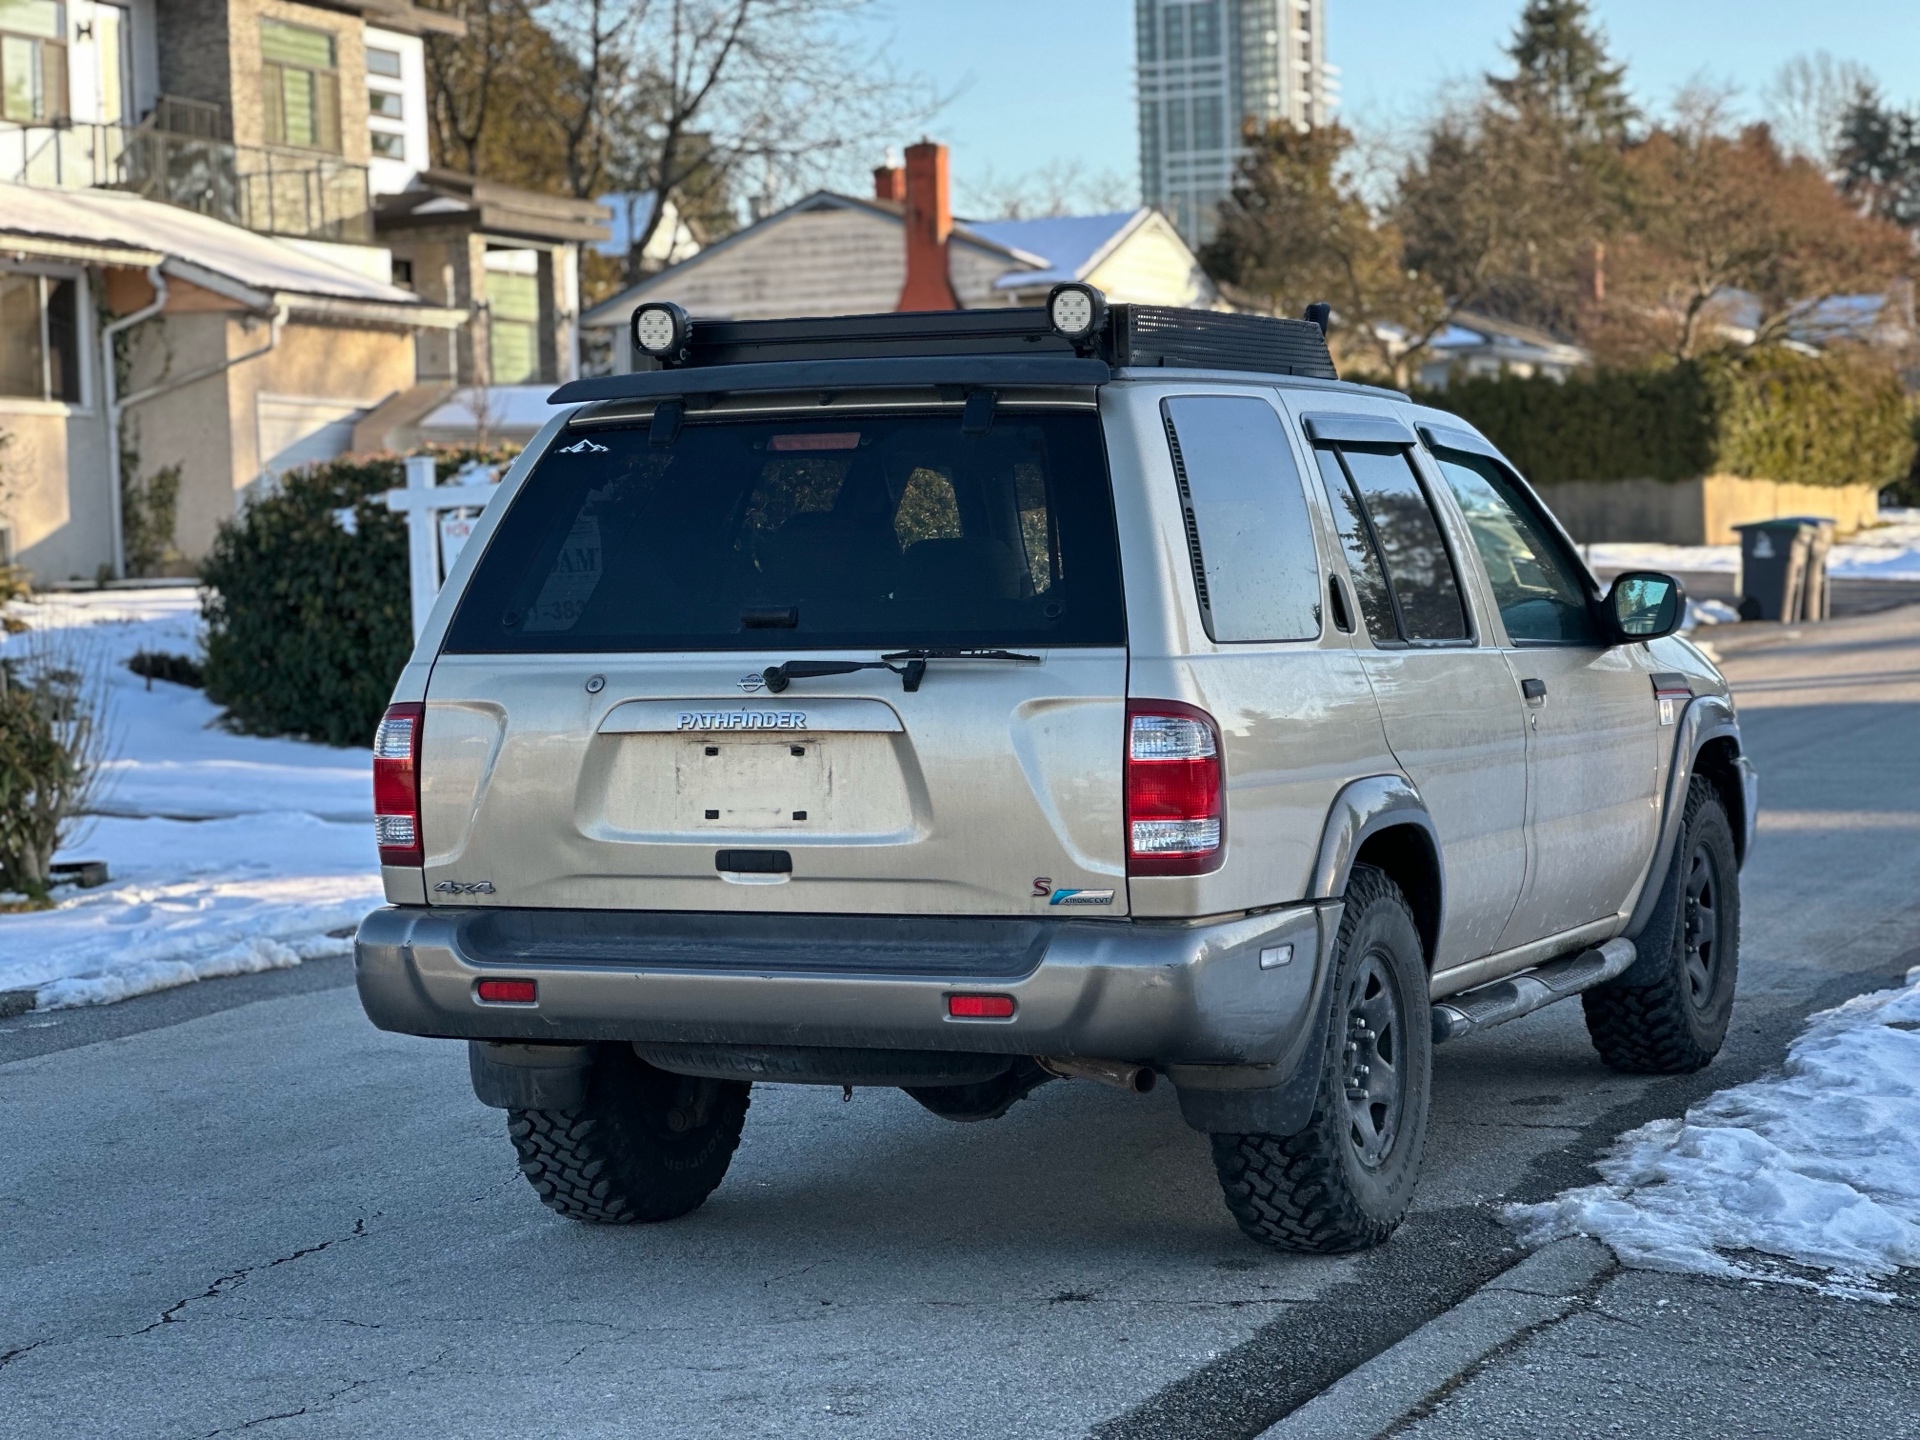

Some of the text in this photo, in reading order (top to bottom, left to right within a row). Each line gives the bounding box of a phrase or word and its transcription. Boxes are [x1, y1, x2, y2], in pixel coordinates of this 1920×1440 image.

[677, 711, 807, 730] PATHFINDER
[434, 881, 496, 894] 4x4
[1031, 877, 1052, 897] S
